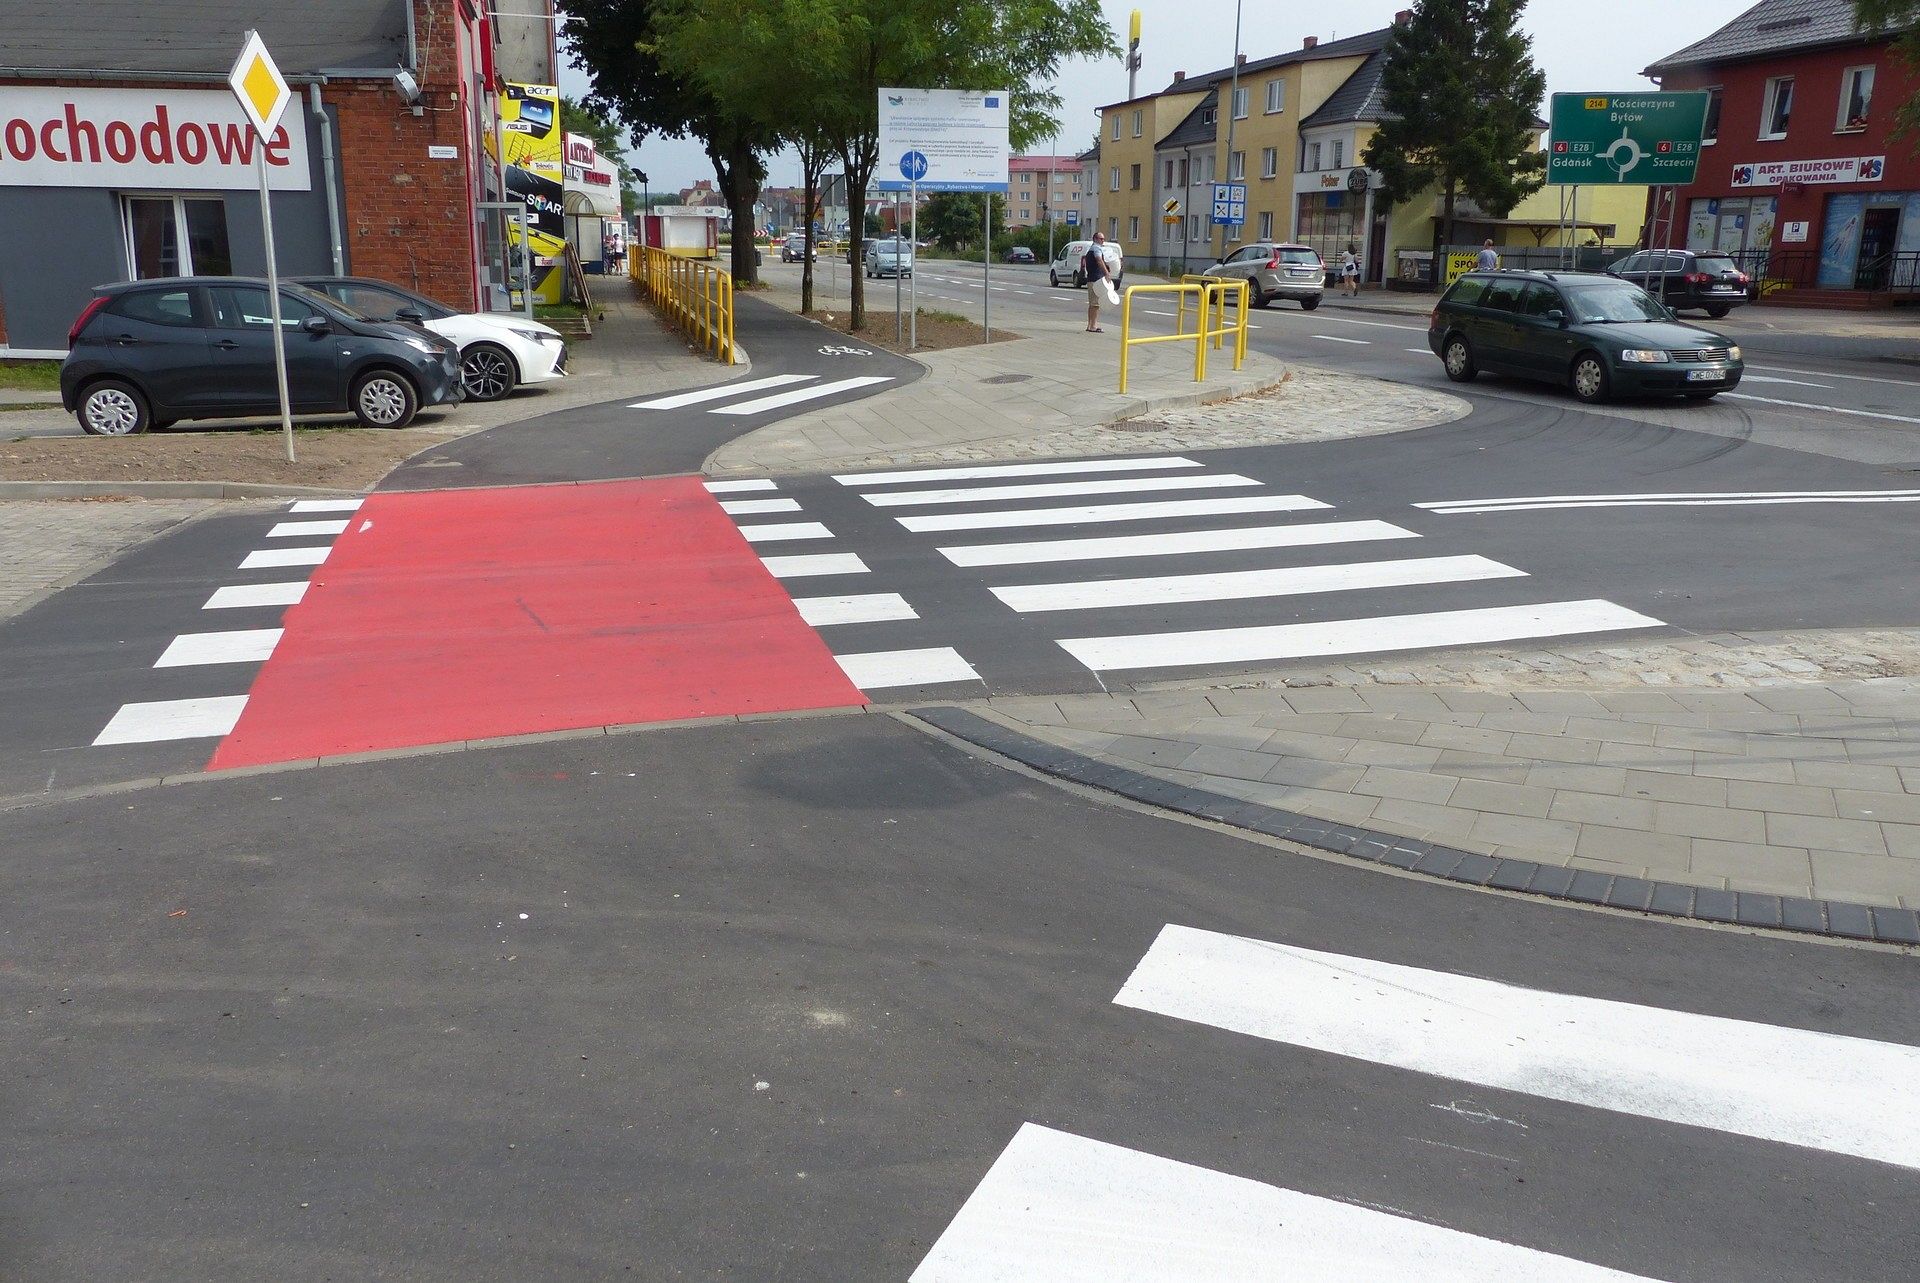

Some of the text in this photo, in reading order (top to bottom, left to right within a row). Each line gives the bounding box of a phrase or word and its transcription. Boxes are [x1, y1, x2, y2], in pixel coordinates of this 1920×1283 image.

[527, 86, 551, 95] acer
[1589, 99, 1675, 112] 214 Kościerzyna
[1610, 112, 1644, 124] Bytów
[0, 103, 291, 167] ochodowe
[1557, 143, 1589, 152] 6 E28
[1660, 143, 1693, 152] 6 E28
[1552, 157, 1592, 168] Gdańsk
[1652, 157, 1694, 168] Szczecin
[1758, 164, 1785, 175] ART.
[1789, 160, 1854, 173] BIUROWE
[1769, 173, 1837, 183] OPAKOWANIA
[1691, 370, 1705, 380] GWE
